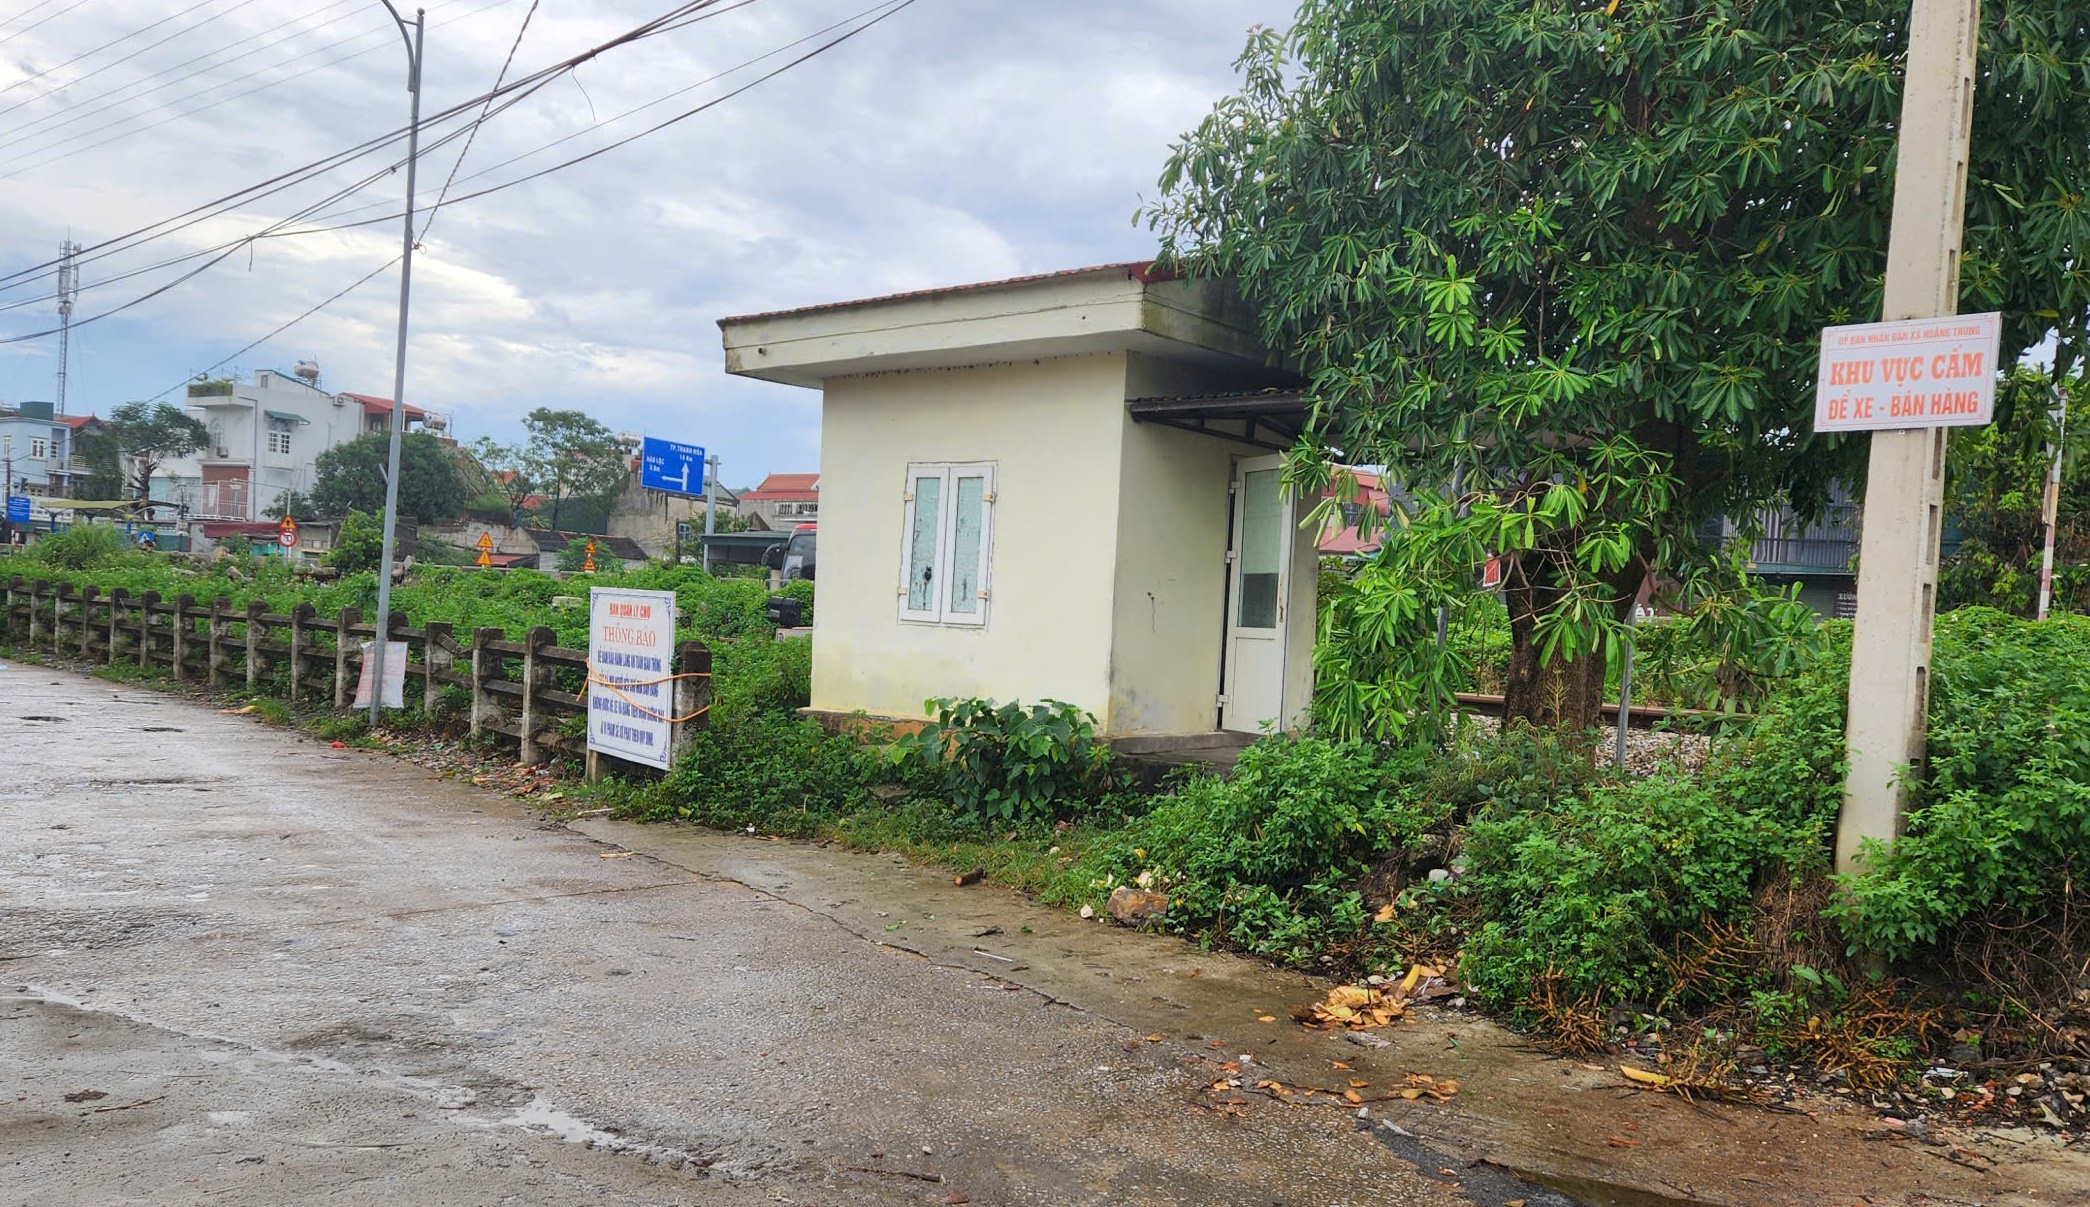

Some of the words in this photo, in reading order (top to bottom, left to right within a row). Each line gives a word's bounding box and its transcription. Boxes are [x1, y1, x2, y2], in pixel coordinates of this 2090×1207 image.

[1954, 325, 1980, 336] TRUNG
[1830, 360, 1874, 386] KHU
[1882, 356, 1924, 388] VỰC
[1931, 344, 1984, 379] CẤM
[1828, 389, 1852, 420] ĐỂ
[1853, 397, 1874, 419] XE
[1890, 390, 1925, 417] BÁN
[1931, 388, 1978, 415] HÀNG
[604, 622, 634, 644] THÔNG
[636, 626, 656, 647] BÁO
